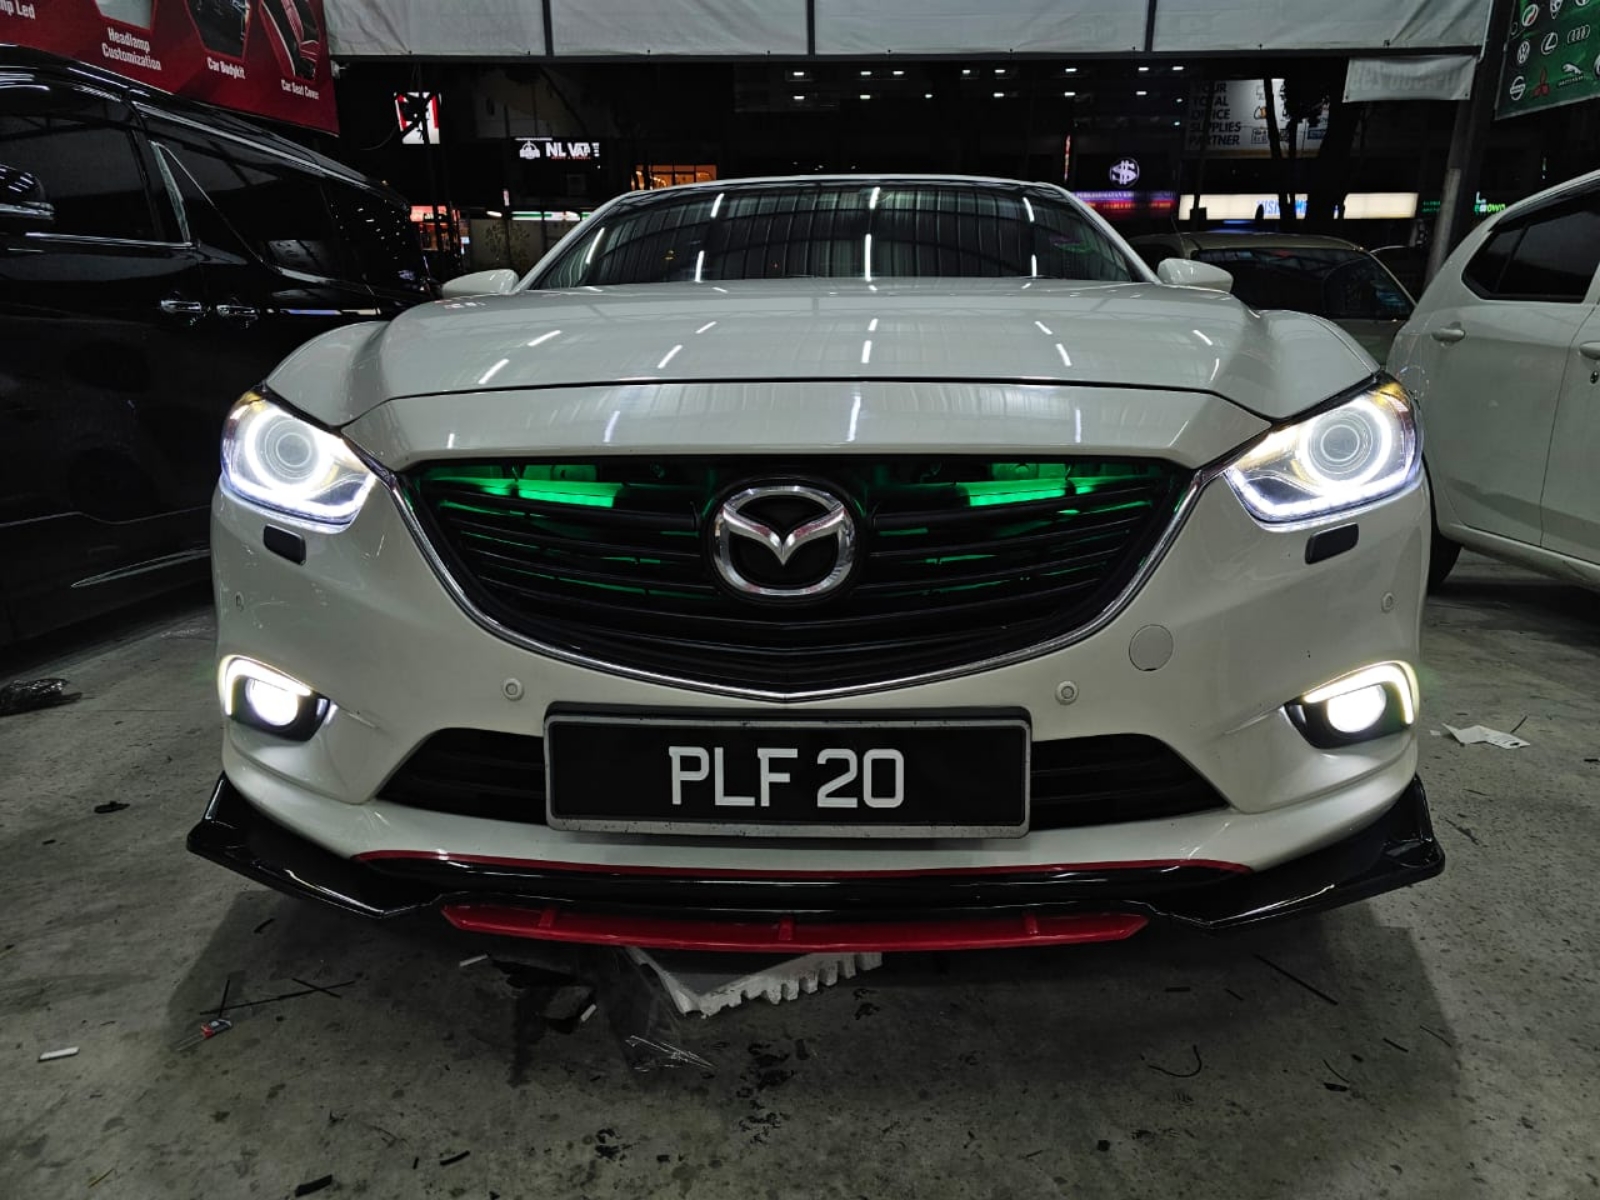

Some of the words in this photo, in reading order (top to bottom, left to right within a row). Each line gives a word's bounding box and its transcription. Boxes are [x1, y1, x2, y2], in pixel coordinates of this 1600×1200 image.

[15, 0, 36, 20] Led
[107, 27, 151, 54] Headlamp
[101, 42, 162, 70] Customization
[207, 57, 220, 72] Car
[220, 61, 246, 79] Bodykit
[281, 79, 292, 92] Car
[545, 142, 566, 157] NL
[668, 745, 798, 807] PLF
[816, 748, 905, 808] 20
